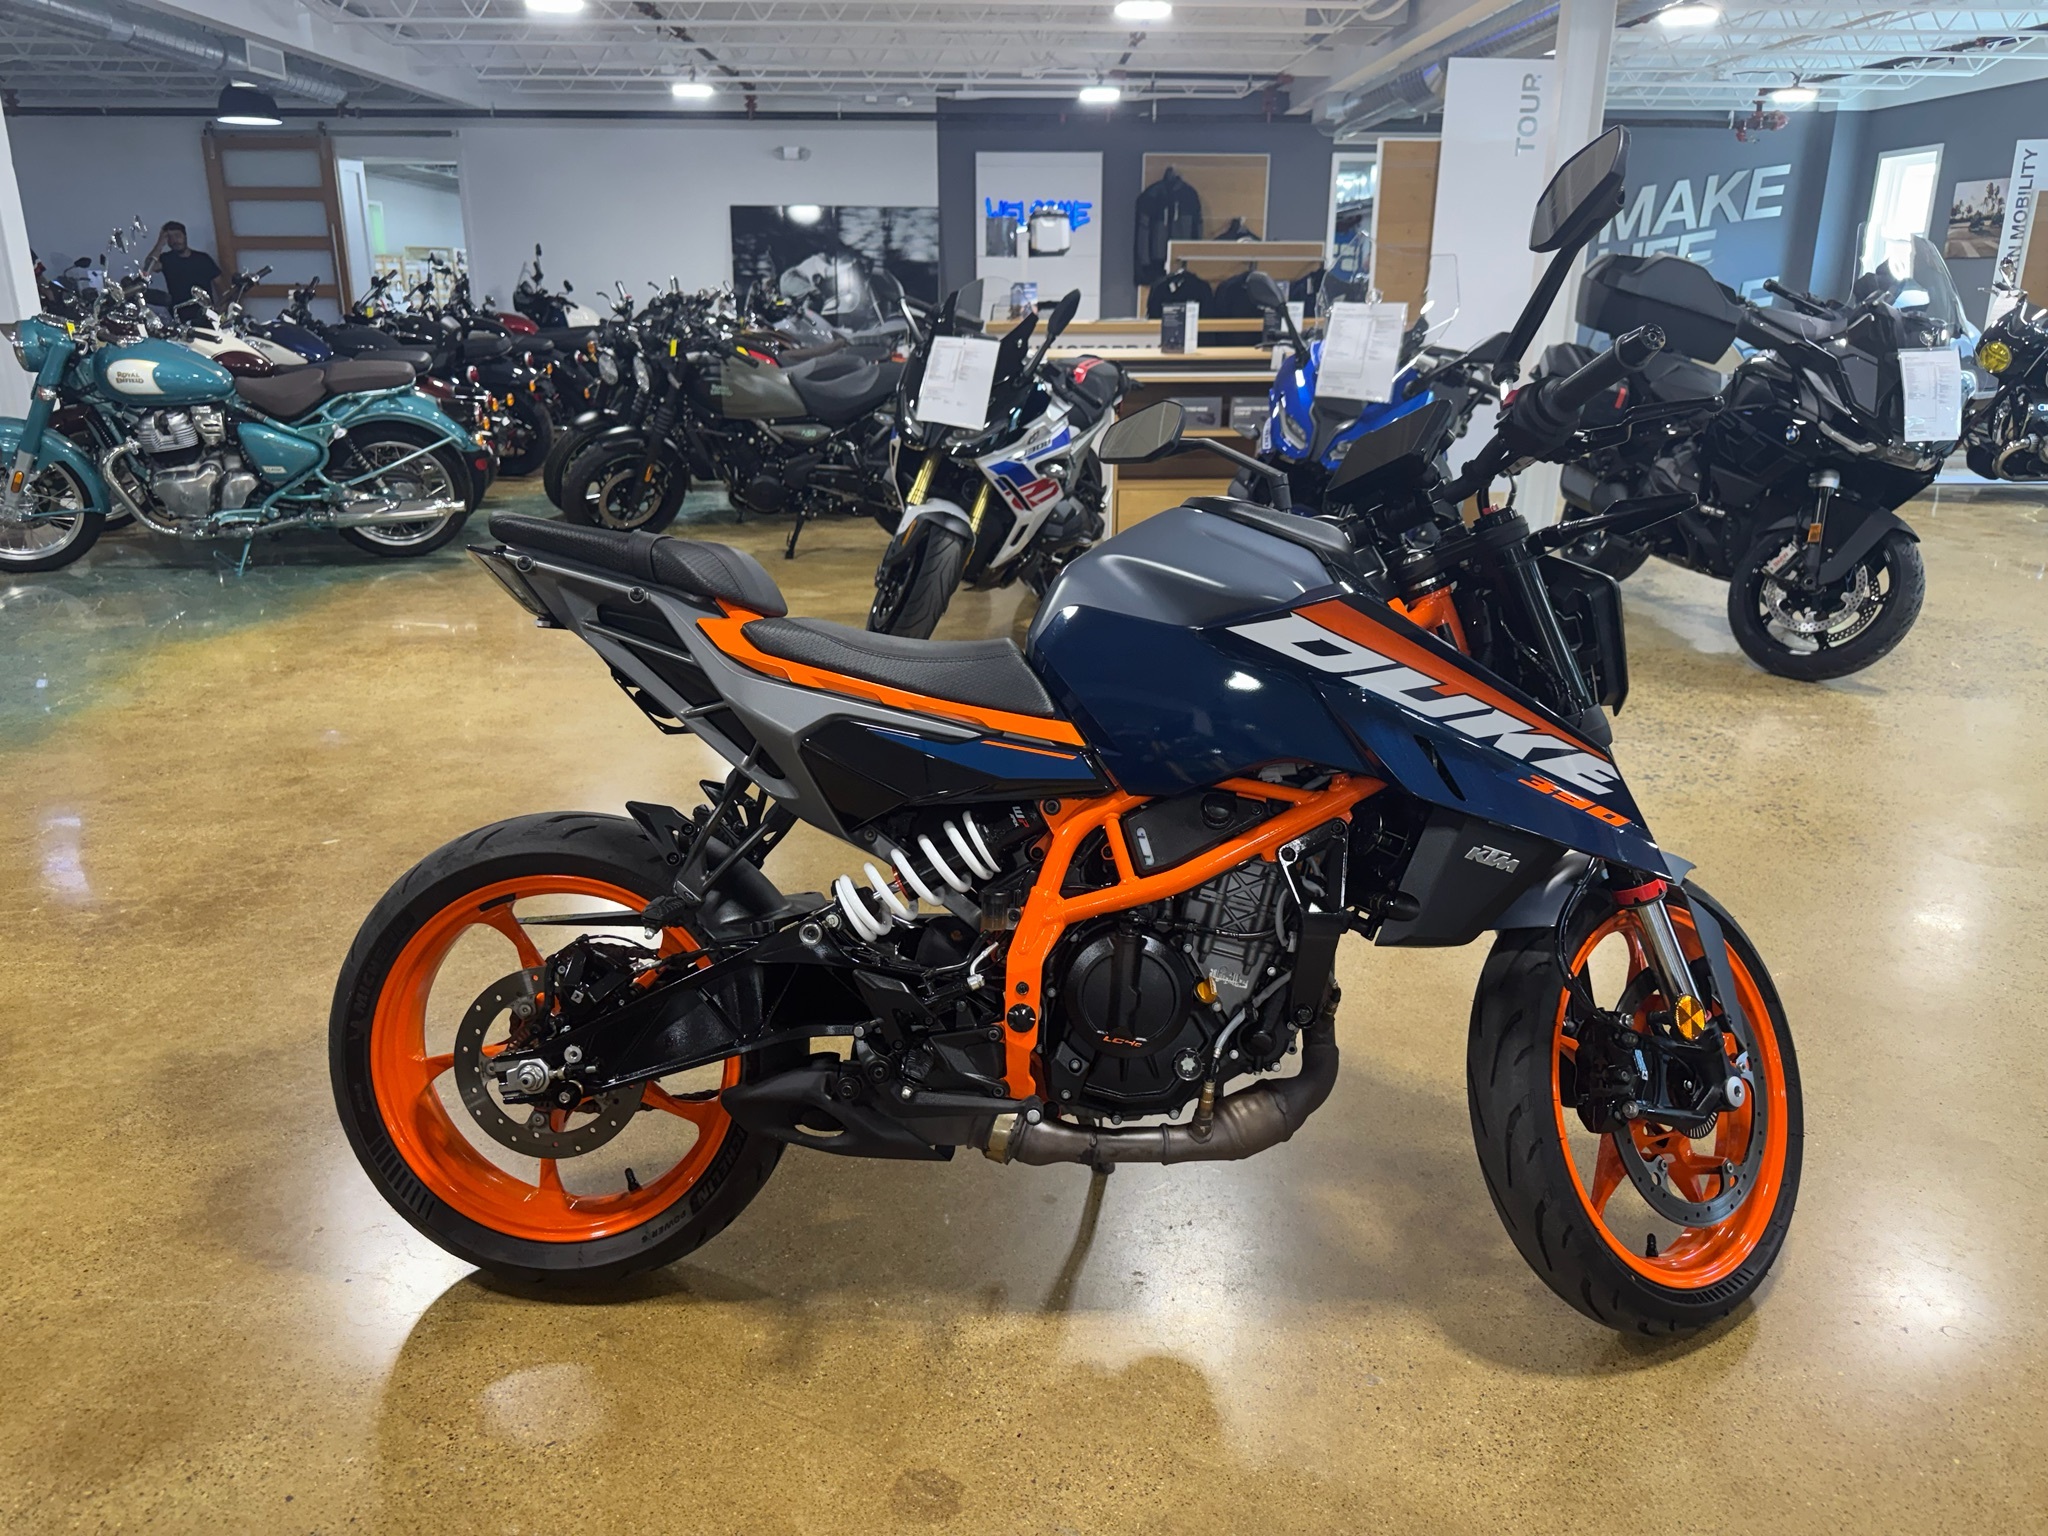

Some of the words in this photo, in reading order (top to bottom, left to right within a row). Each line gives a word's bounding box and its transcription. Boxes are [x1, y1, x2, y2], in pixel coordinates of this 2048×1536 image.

[984, 197, 1093, 232] WELME
[1597, 163, 1792, 245] MAKE
[2010, 148, 2038, 240] MOBILITY
[1225, 611, 1621, 796] DUKE
[1518, 774, 1632, 827] 390
[1464, 844, 1520, 873] KTM
[696, 1126, 747, 1205] ICHELIN
[651, 1209, 687, 1238] POWER
